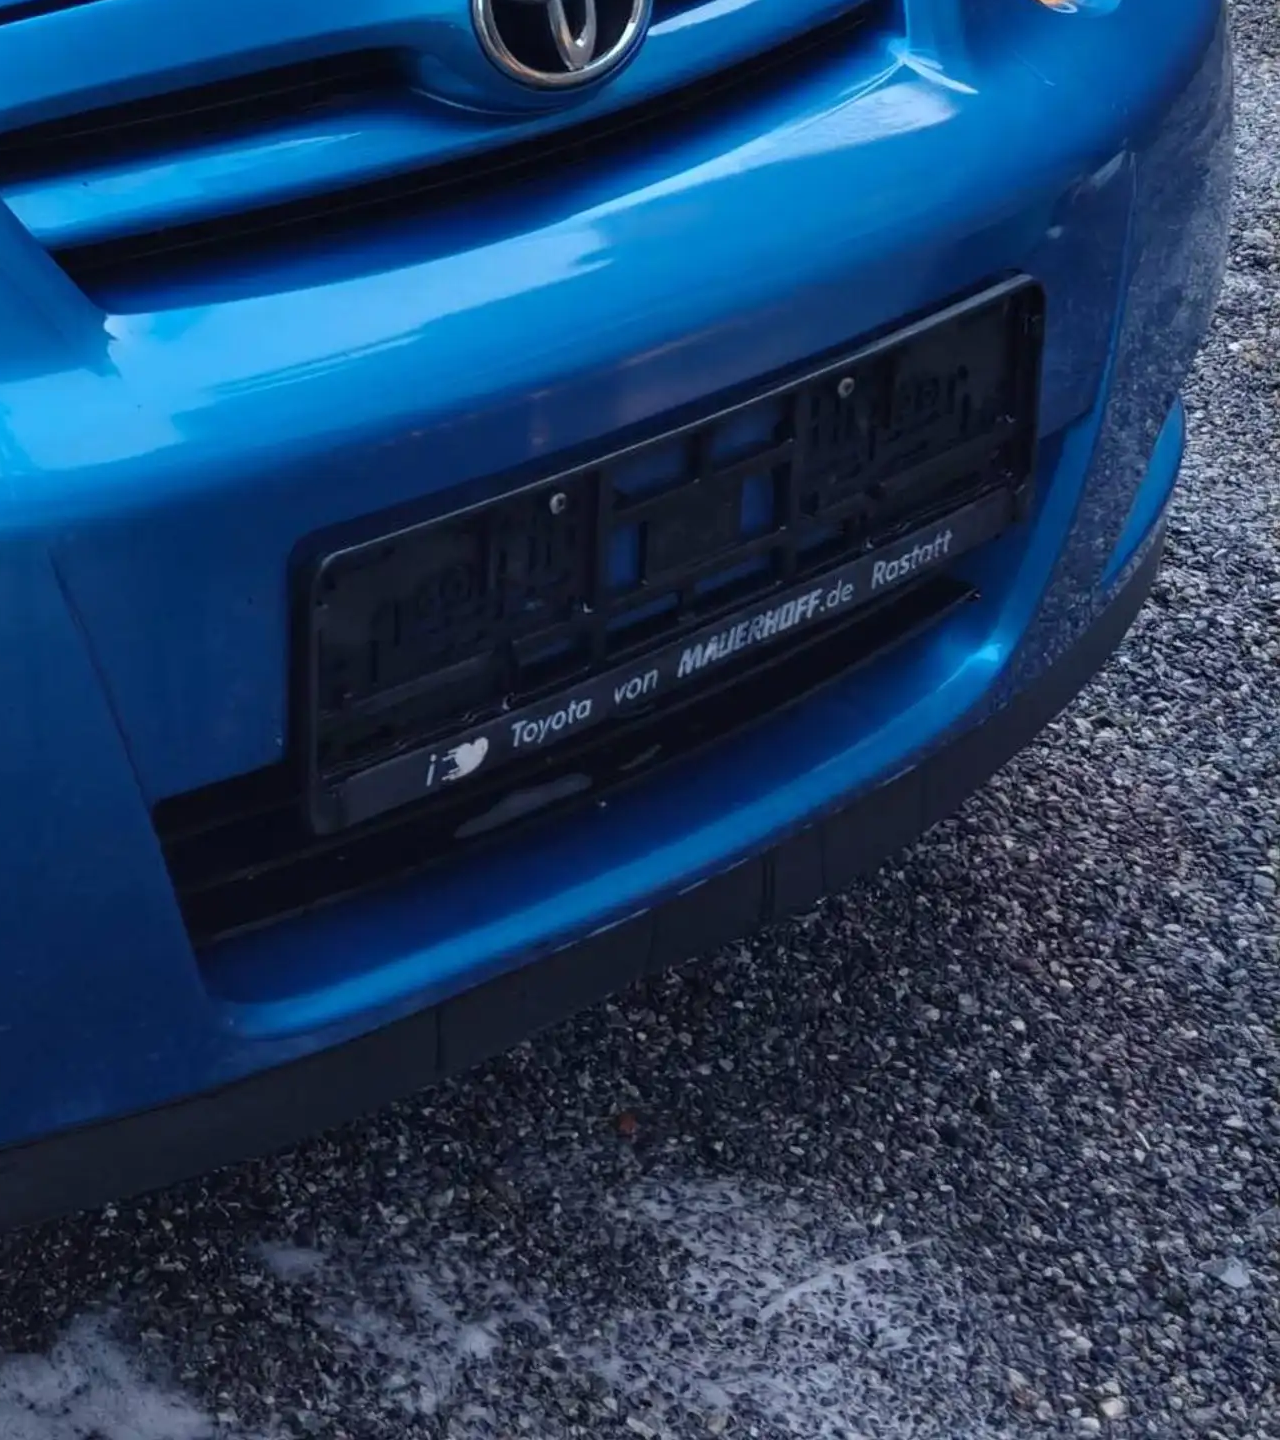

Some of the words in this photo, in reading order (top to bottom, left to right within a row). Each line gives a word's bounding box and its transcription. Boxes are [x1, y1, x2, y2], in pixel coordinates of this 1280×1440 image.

[510, 698, 593, 748] Toyota
[613, 668, 659, 705] von
[676, 579, 855, 679] MAUERHOFF.de
[870, 528, 954, 590] Rastatt
